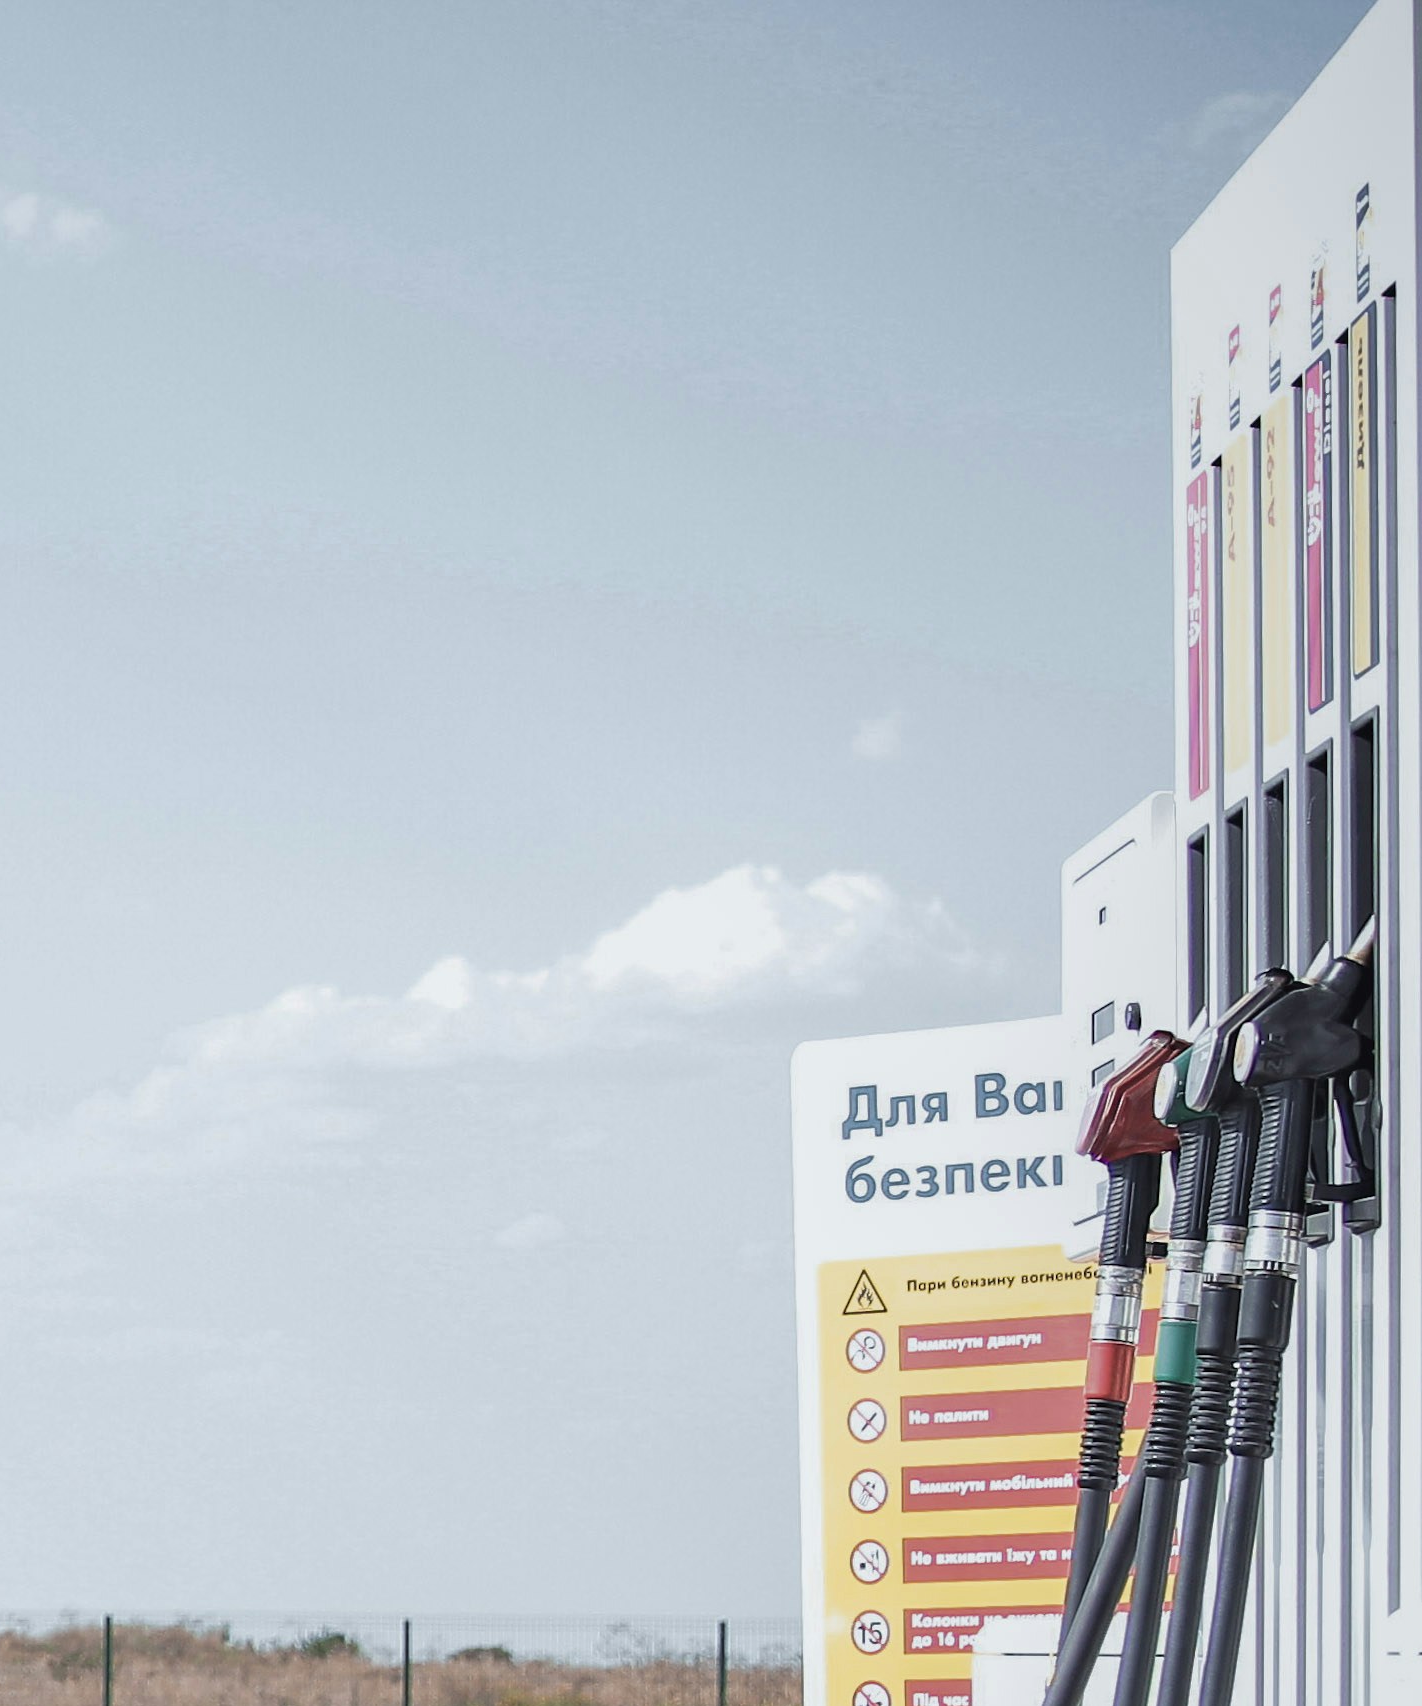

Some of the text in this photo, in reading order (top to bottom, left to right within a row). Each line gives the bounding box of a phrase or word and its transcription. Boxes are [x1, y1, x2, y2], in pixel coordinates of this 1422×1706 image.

[842, 1084, 949, 1140] Для
[907, 1279, 946, 1293] Пари
[951, 1275, 1015, 1290] бензину
[907, 1332, 1042, 1352] Вимкнути двигун
[908, 1408, 989, 1425] Не палити
[909, 1472, 1074, 1496] Вимкнути мобільний
[911, 1551, 932, 1565] Не
[936, 1551, 1003, 1565] вживати
[1006, 1548, 1035, 1565] їжу
[1039, 1549, 1058, 1561] та
[911, 1613, 979, 1629] Колонки
[911, 1634, 932, 1649] до
[936, 1630, 954, 1648] 16
